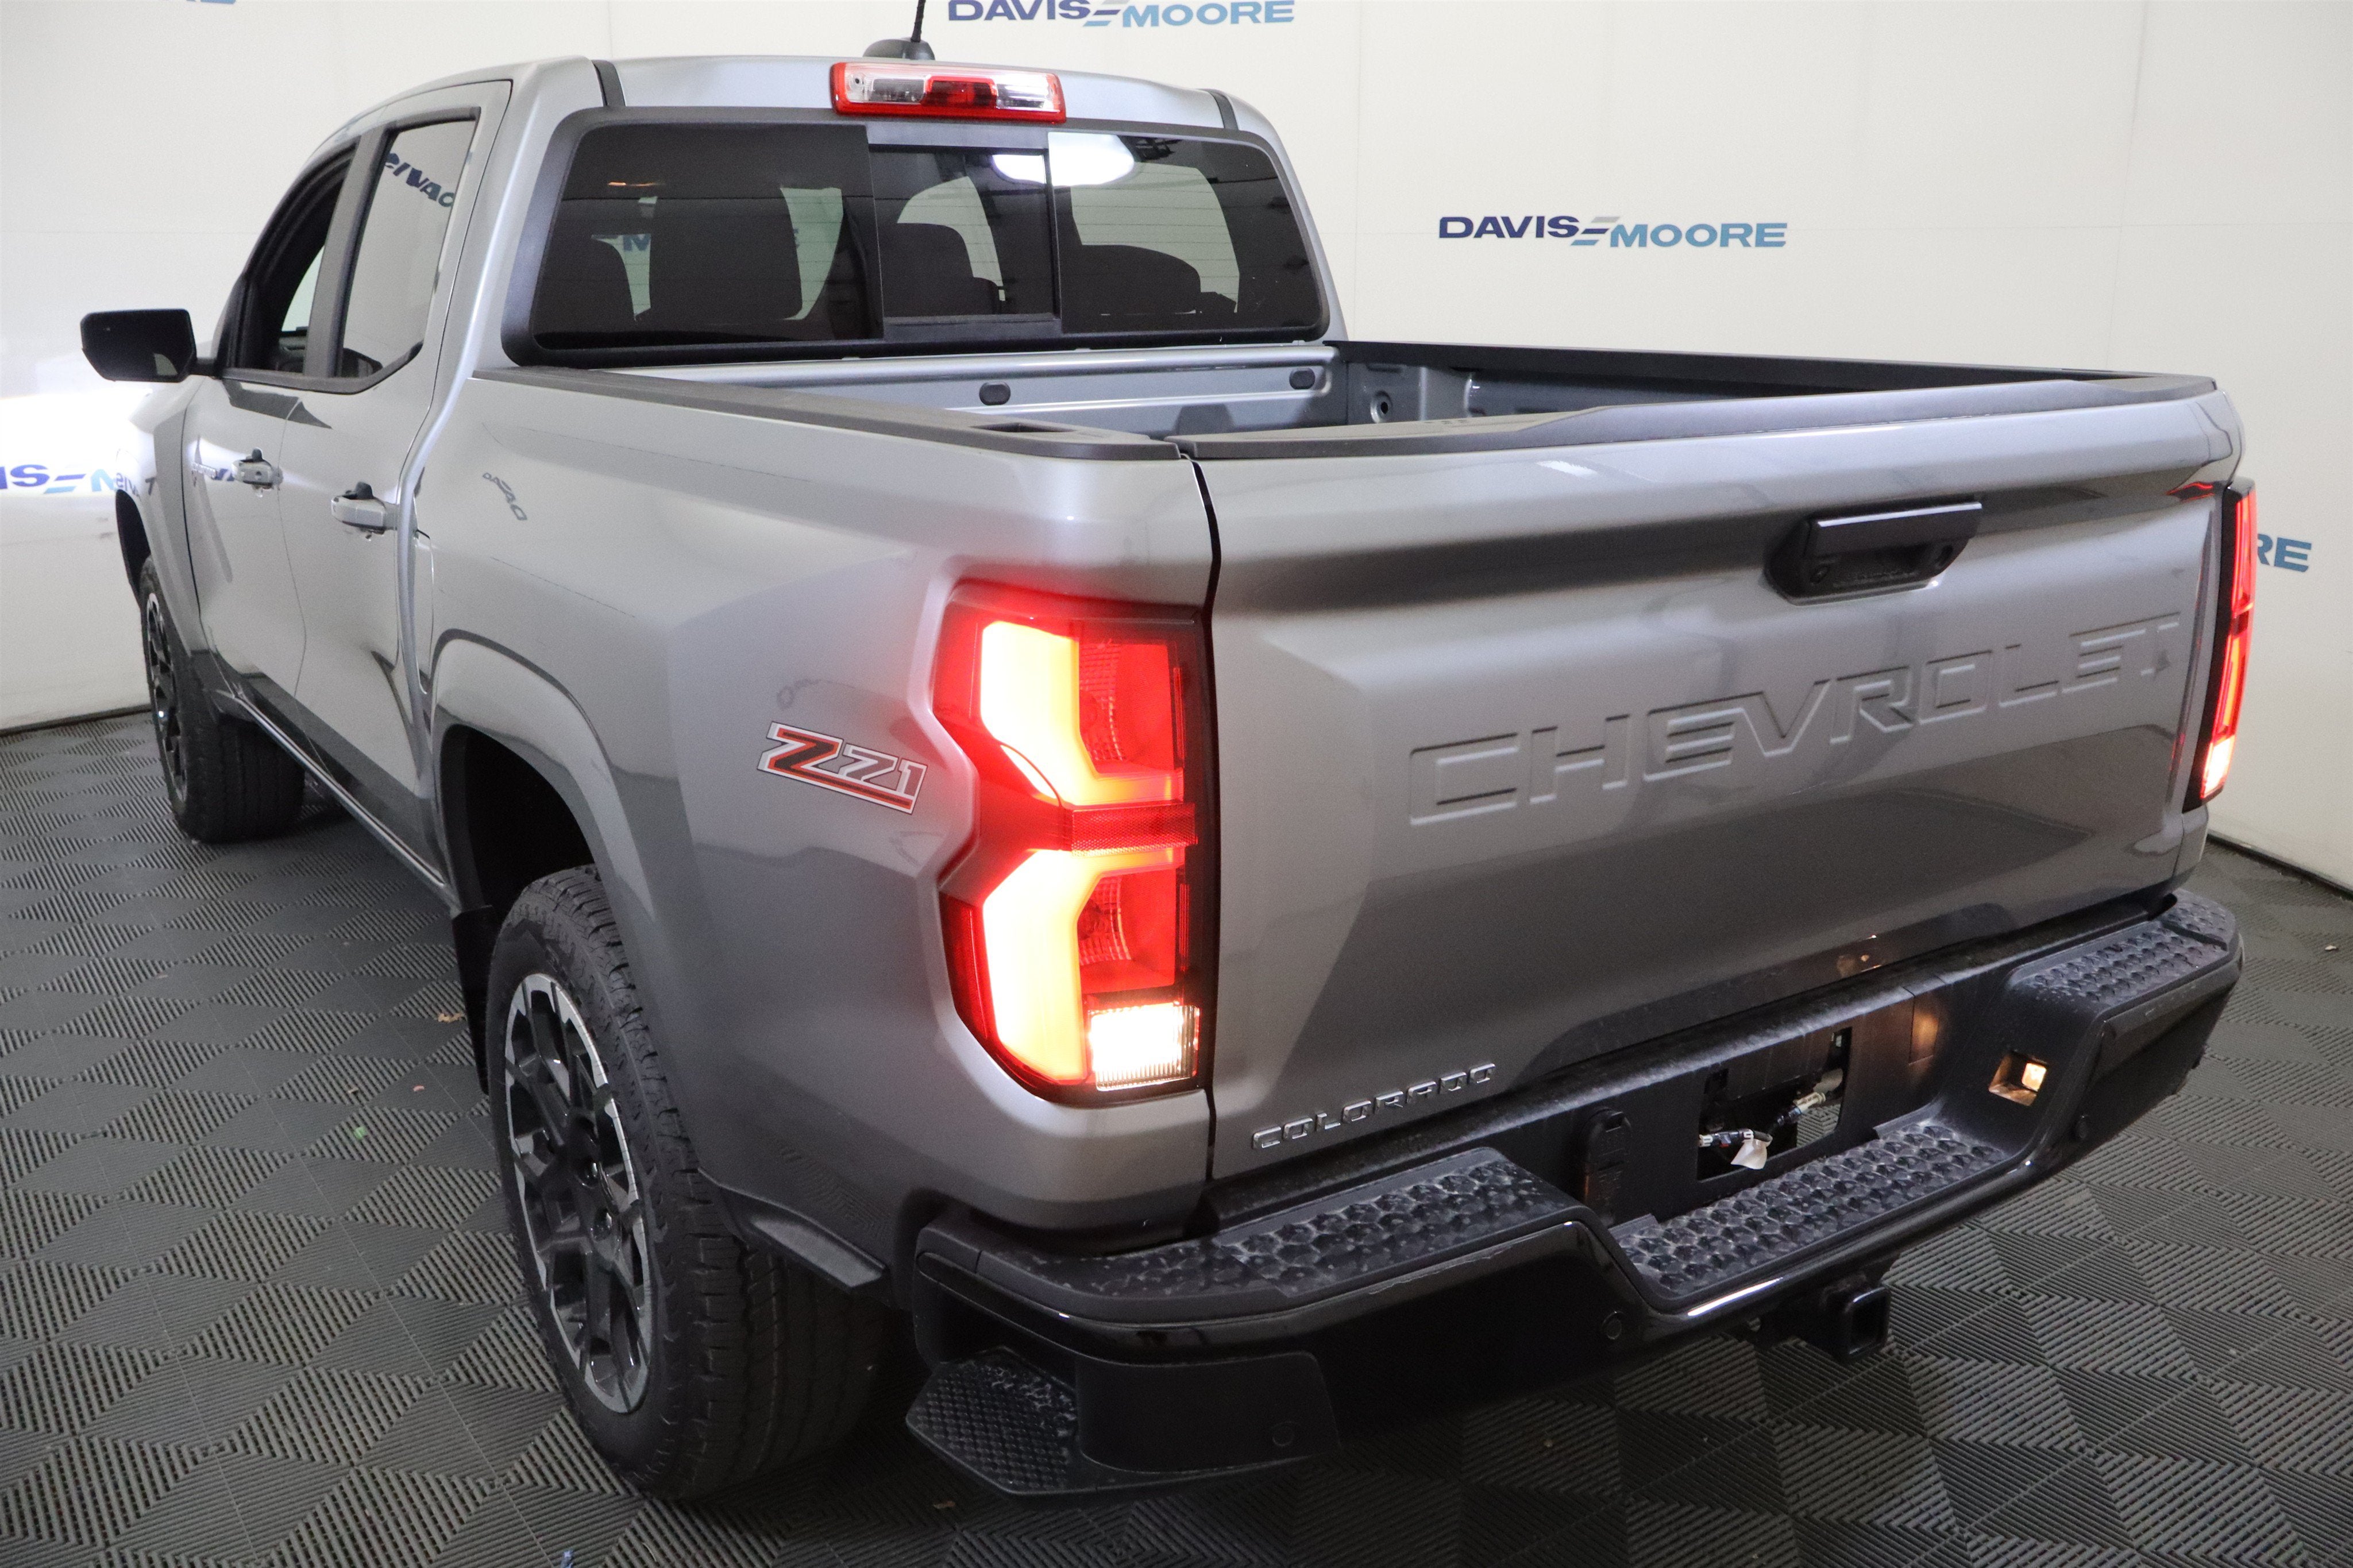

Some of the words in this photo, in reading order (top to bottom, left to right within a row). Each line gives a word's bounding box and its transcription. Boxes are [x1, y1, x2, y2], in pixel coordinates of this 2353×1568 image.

[948, 0, 1091, 21] DAVIS
[1123, 0, 1295, 28] MOORE
[1438, 215, 1580, 238] DAVIS
[1610, 222, 1788, 248] MOORE
[1409, 611, 2181, 826] CHEVROLET
[756, 720, 928, 815] Z71
[1252, 1063, 1496, 1150] COLORADO
